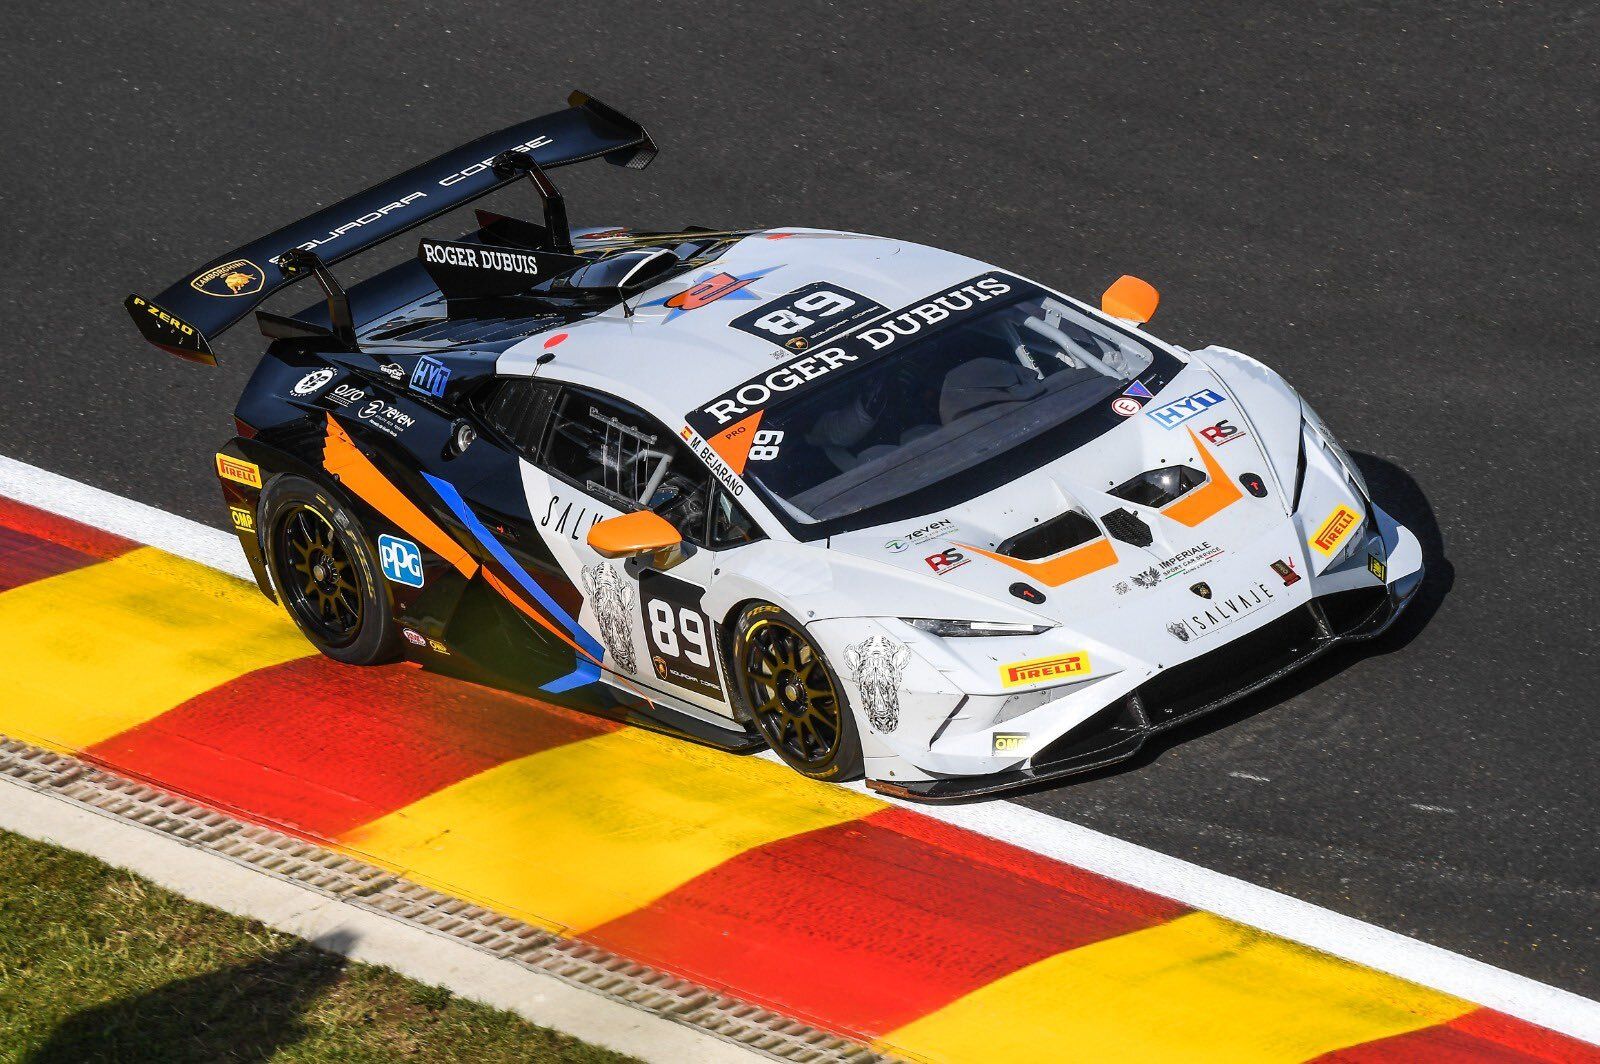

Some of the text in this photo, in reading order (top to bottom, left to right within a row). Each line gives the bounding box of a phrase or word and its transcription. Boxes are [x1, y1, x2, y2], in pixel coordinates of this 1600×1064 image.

[195, 261, 246, 288] LAMBORGHINI
[423, 243, 538, 275] ROGER DUBUIS
[133, 297, 194, 336] P ZERO
[753, 290, 856, 335] 89
[704, 278, 1011, 424] ROGER DUBUIS
[1154, 390, 1227, 424] HYT
[726, 427, 746, 439] PRO
[748, 430, 785, 461] 89
[1199, 419, 1238, 444] RS
[219, 458, 258, 483] PIRELLI
[690, 436, 745, 497] M. BEJARANO
[232, 510, 253, 529] OMP
[1314, 509, 1355, 551] PIRELLI
[381, 541, 420, 578] PPG
[924, 547, 964, 572] RS
[1158, 541, 1212, 570] IMPERIALE
[1162, 564, 1182, 577] SPORT
[1182, 558, 1195, 567] CAR
[1372, 558, 1382, 578] OMP
[1191, 583, 1274, 631] SALVAJE
[647, 598, 711, 668] 89
[1008, 656, 1082, 682] PIRELLI
